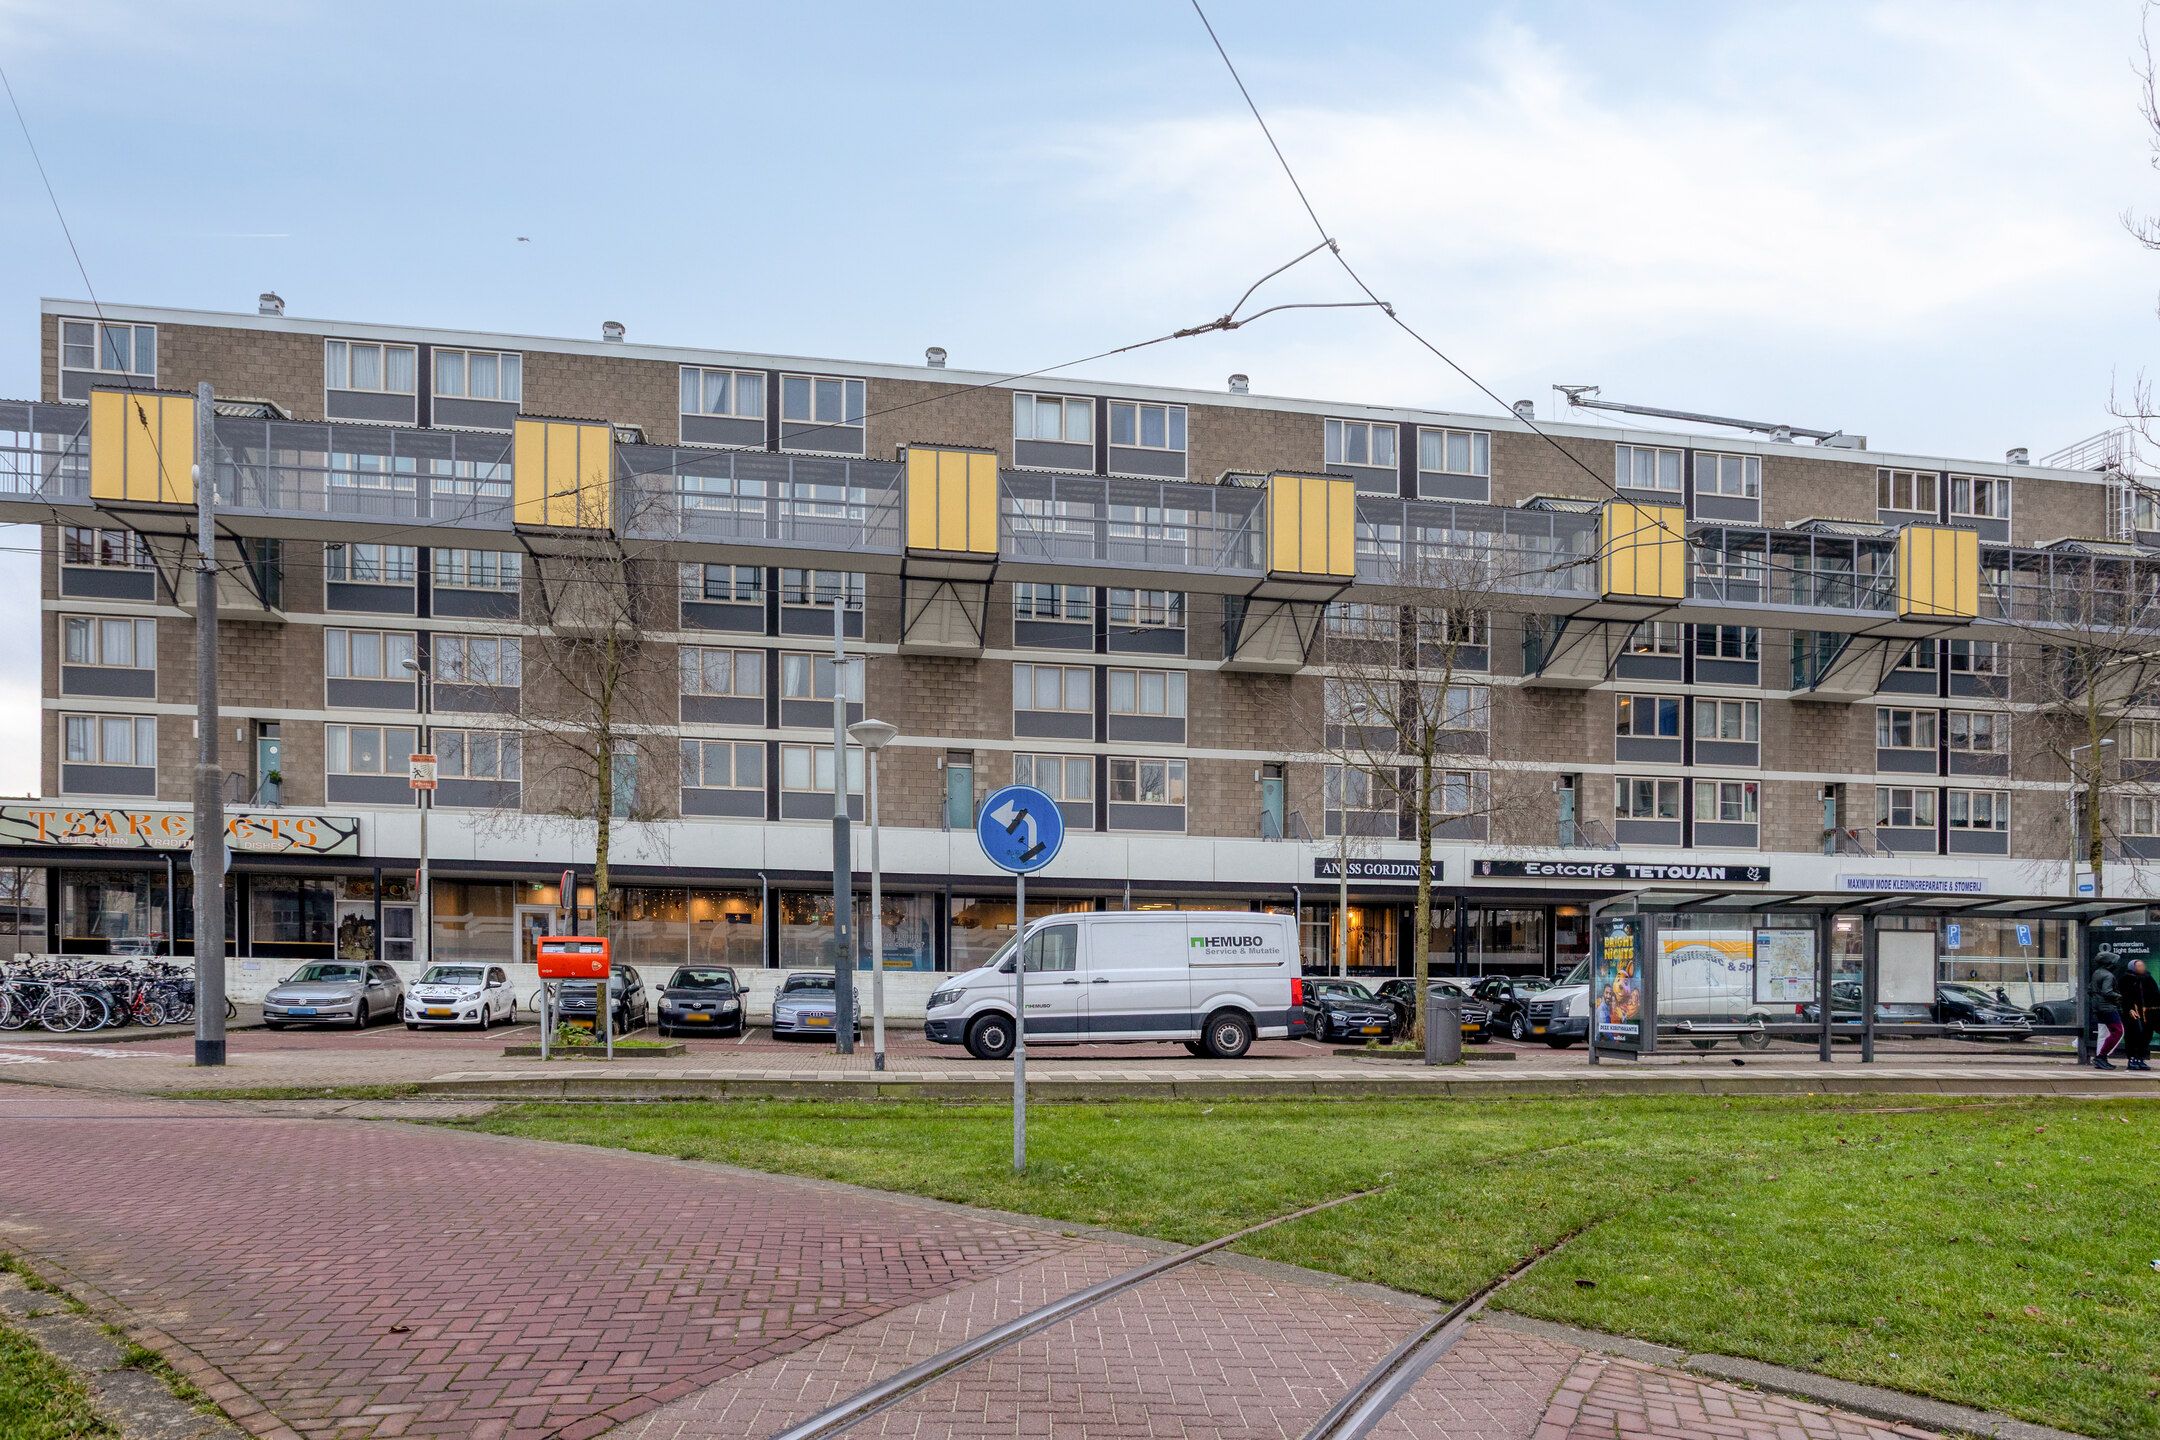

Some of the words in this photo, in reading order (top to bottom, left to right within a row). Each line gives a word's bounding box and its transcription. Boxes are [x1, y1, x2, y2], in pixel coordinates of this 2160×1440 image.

[28, 810, 318, 848] TSAREETS
[60, 836, 128, 846] BULGARIAN
[244, 842, 285, 850] DISHES
[1322, 862, 1361, 875] ANSS
[1364, 864, 1436, 876] GORDIJNN
[1525, 862, 1616, 878] Eetcafé
[1626, 865, 1726, 880] TETOUAN
[1847, 878, 1875, 889] MAXIMUM
[1876, 879, 1892, 890] MODE
[1893, 879, 1947, 892] KLEIDINGREPARATIE
[1954, 881, 1982, 892] STOMERIJ
[1205, 936, 1263, 947] HEMUBO
[1728, 962, 1736, 971] &
